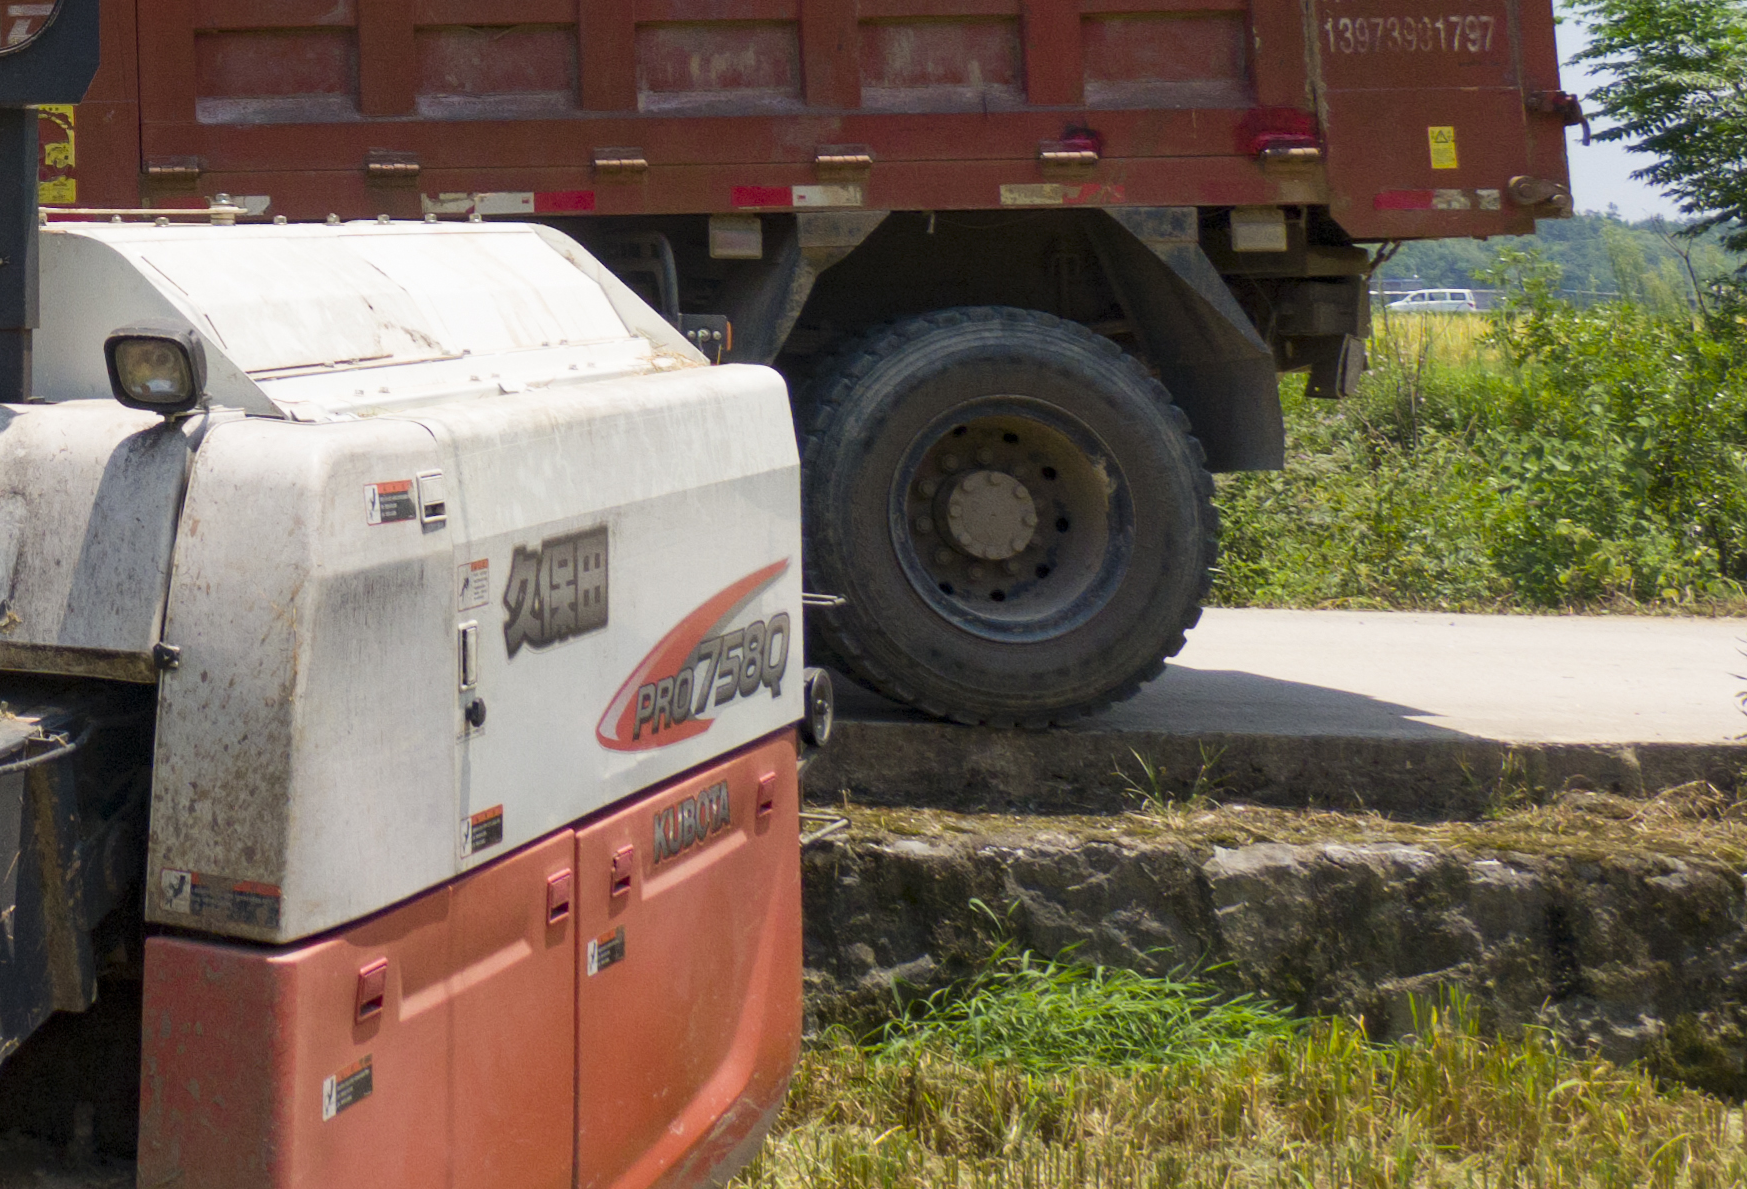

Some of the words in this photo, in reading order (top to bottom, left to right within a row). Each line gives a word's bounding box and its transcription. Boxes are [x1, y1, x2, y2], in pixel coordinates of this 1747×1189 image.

[503, 523, 608, 660] 久保田
[654, 780, 731, 864] KUBOTA
